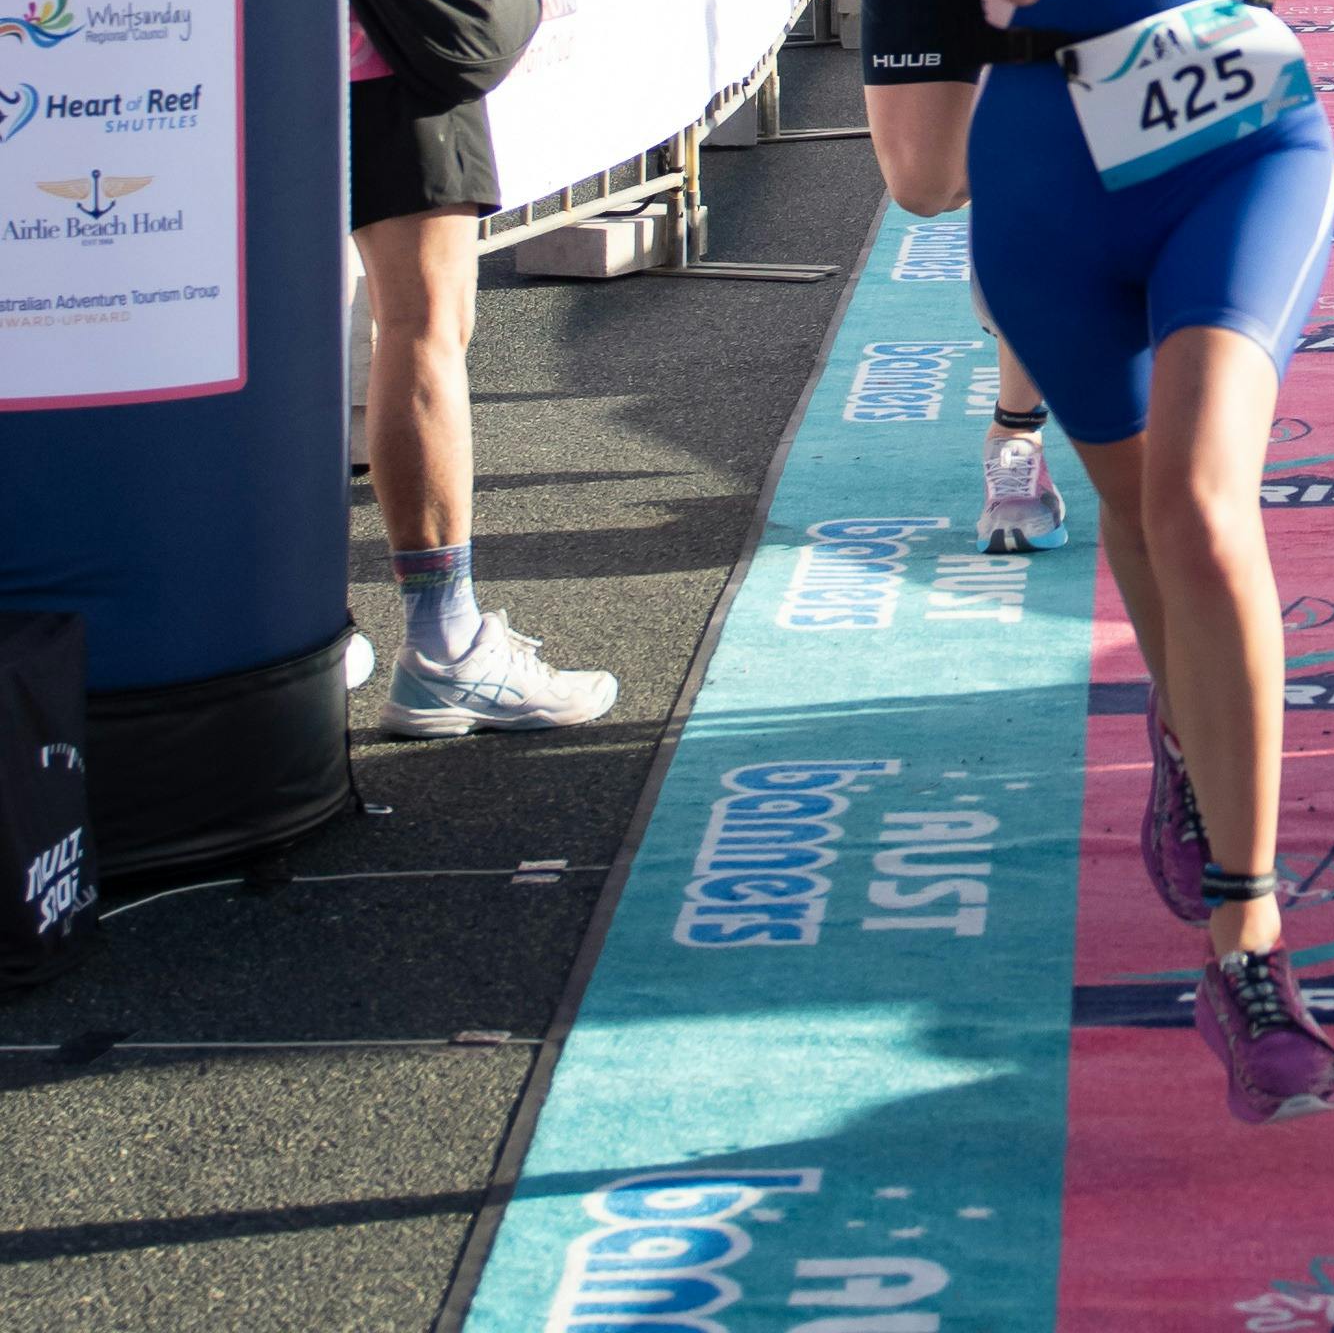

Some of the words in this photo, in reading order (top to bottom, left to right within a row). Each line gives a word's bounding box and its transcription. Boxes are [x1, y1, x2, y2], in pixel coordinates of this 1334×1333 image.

[86, 1, 192, 42] Whitsunday
[872, 52, 942, 68] HUUB
[46, 94, 122, 119] Heart
[146, 84, 203, 114] Reef
[1139, 47, 1257, 133] 425
[105, 114, 199, 134] SHUTTLES
[2, 218, 61, 241] Airlie
[66, 214, 127, 238] Beach
[132, 209, 184, 234] Hotel
[55, 293, 128, 310] Adventure
[130, 288, 181, 306] Tourism
[183, 284, 221, 300] Group
[842, 340, 985, 423] banners
[774, 516, 951, 632] banners
[924, 553, 1034, 624] AUST
[672, 760, 903, 951] banners
[860, 809, 1001, 937] AUST
